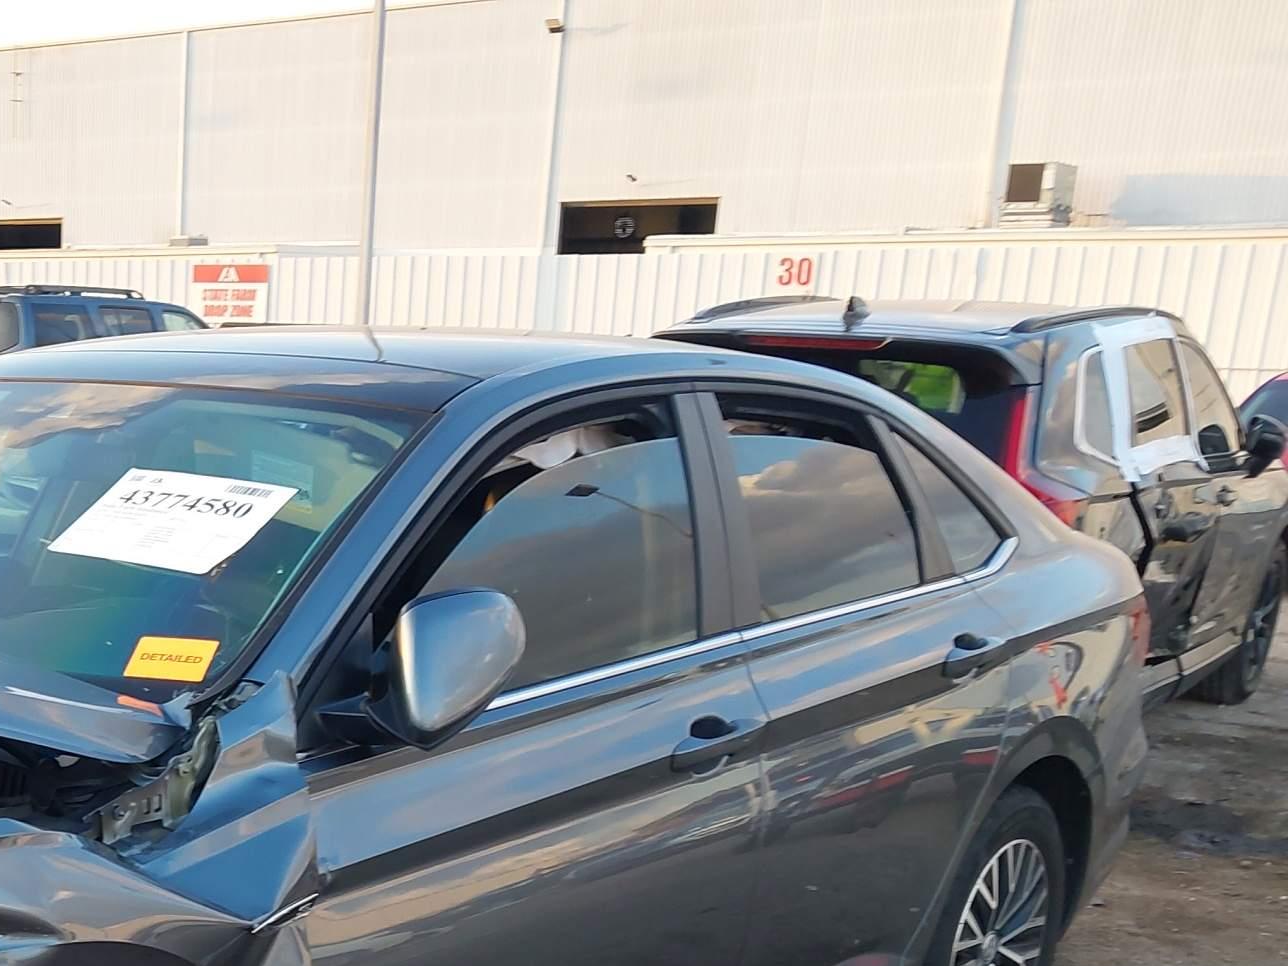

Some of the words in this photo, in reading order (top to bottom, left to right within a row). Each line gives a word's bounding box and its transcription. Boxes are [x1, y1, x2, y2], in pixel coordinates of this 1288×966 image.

[779, 257, 812, 286] 30
[119, 489, 254, 519] 43774580
[139, 652, 204, 664] DETAILED
